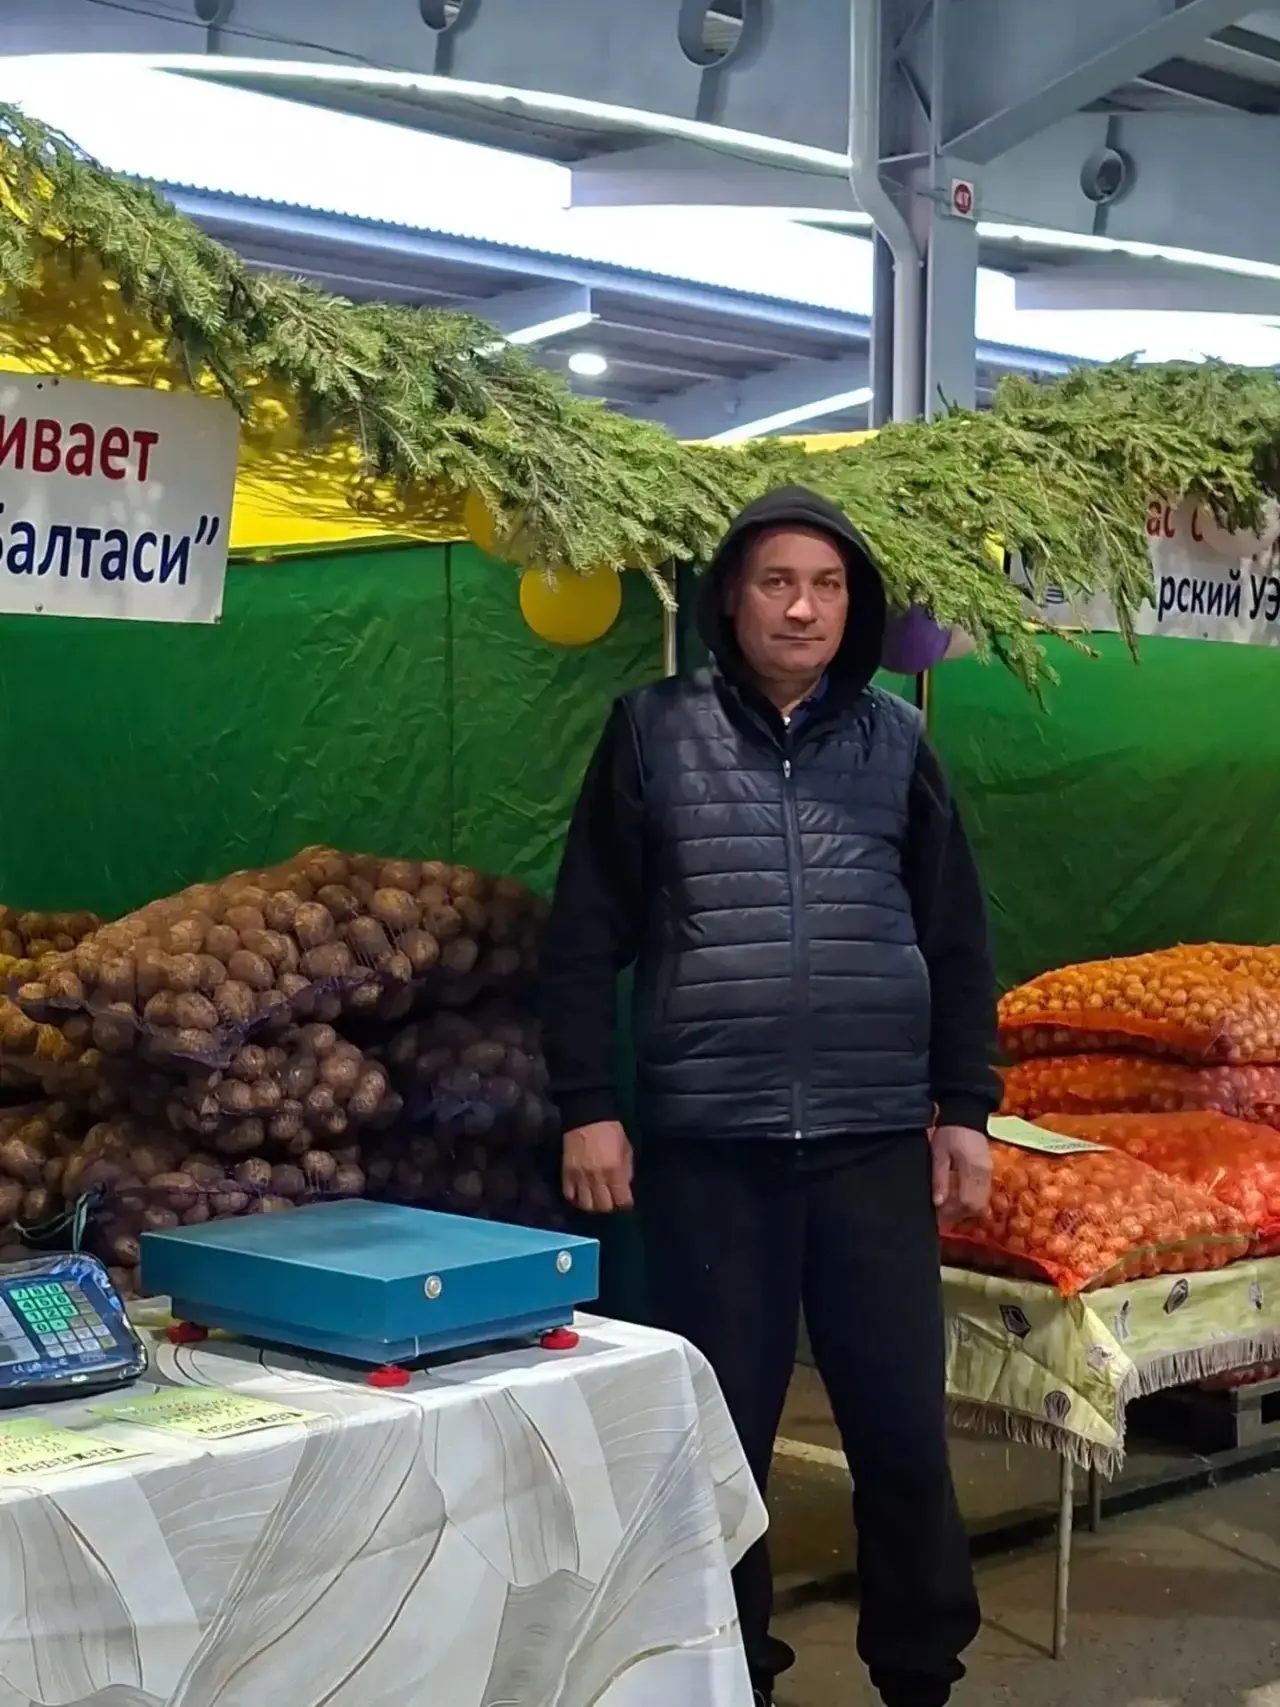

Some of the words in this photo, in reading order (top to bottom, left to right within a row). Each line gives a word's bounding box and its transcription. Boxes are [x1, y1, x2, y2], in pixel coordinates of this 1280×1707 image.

[0, 414, 159, 482] ивает
[0, 503, 220, 586] алтаси”
[1146, 501, 1176, 539] ас
[1157, 568, 1242, 623] рский
